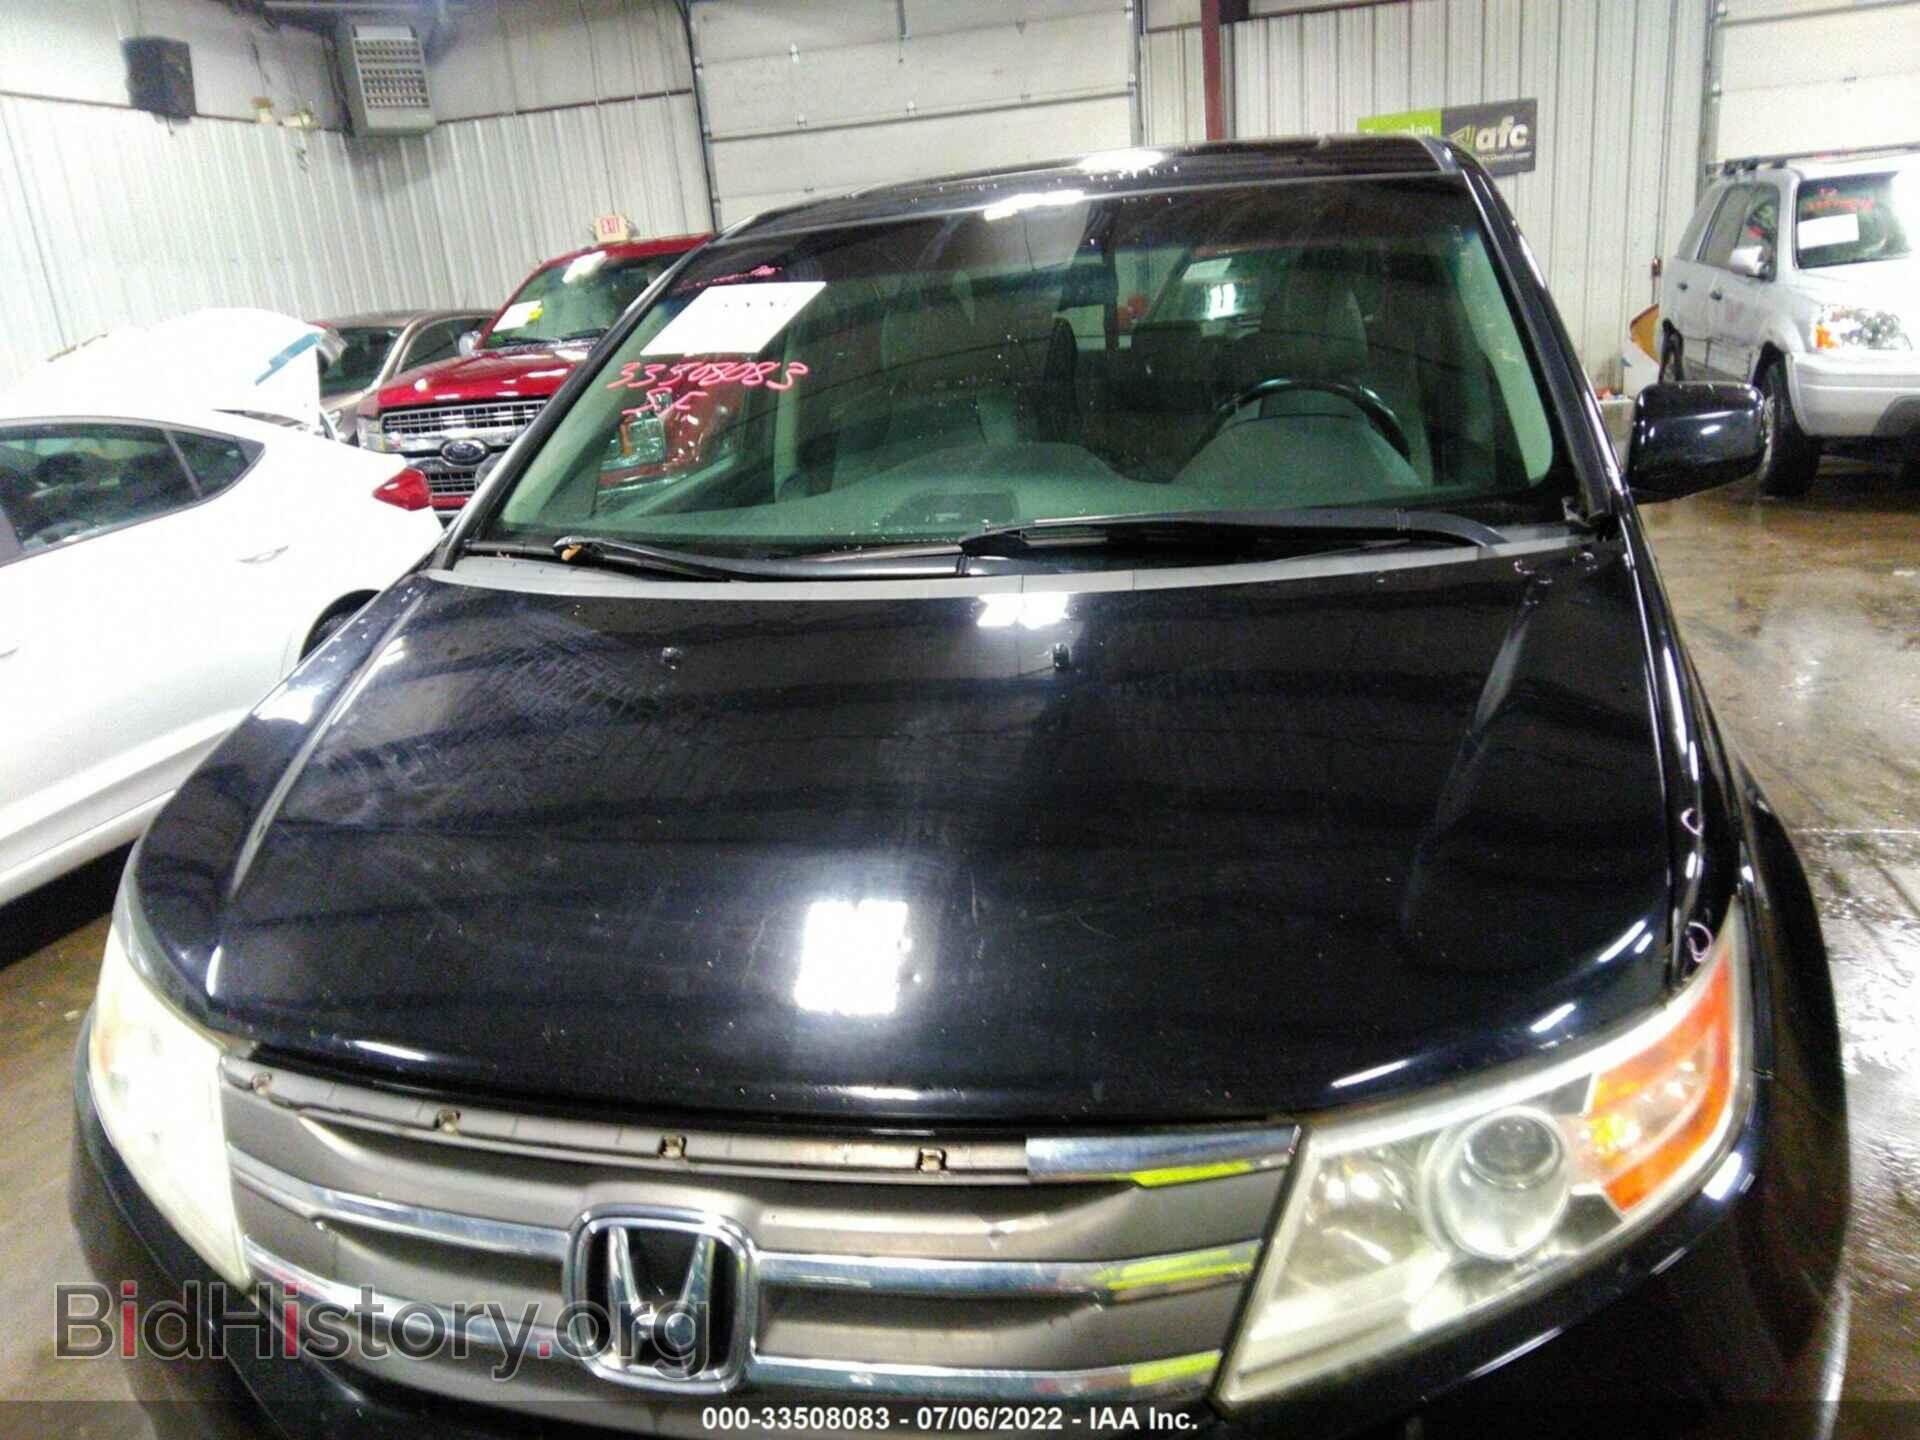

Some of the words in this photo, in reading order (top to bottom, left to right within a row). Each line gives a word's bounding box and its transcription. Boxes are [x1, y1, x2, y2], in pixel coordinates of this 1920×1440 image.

[1476, 116, 1529, 150] afc
[600, 217, 622, 234] EXIT
[606, 361, 810, 390] 33508083
